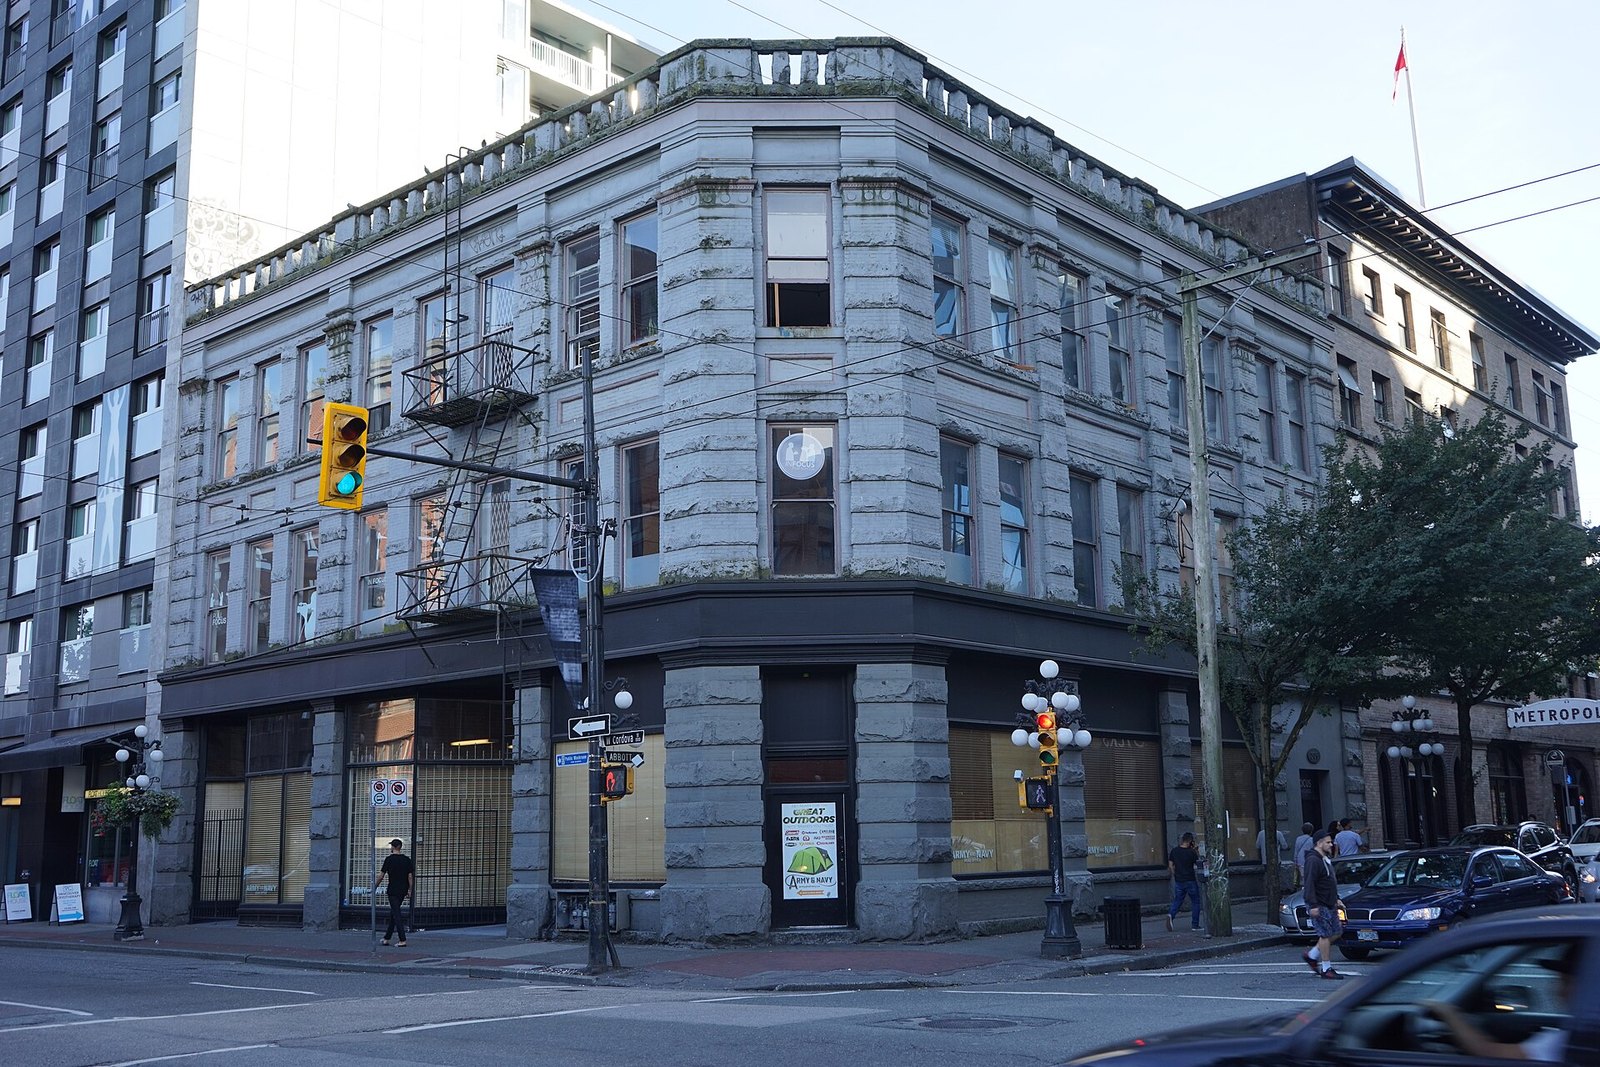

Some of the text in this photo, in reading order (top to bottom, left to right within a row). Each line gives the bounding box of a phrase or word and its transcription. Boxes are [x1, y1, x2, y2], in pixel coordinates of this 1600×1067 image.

[612, 734, 634, 744] Cordova
[609, 752, 632, 761] ABBOTT
[793, 808, 825, 816] GREAT
[783, 816, 836, 824] OUTDOORS
[952, 850, 971, 859] ARMY
[975, 849, 994, 859] NAVY
[1087, 846, 1120, 854] RMY NAVY
[816, 876, 833, 884] NAVY
